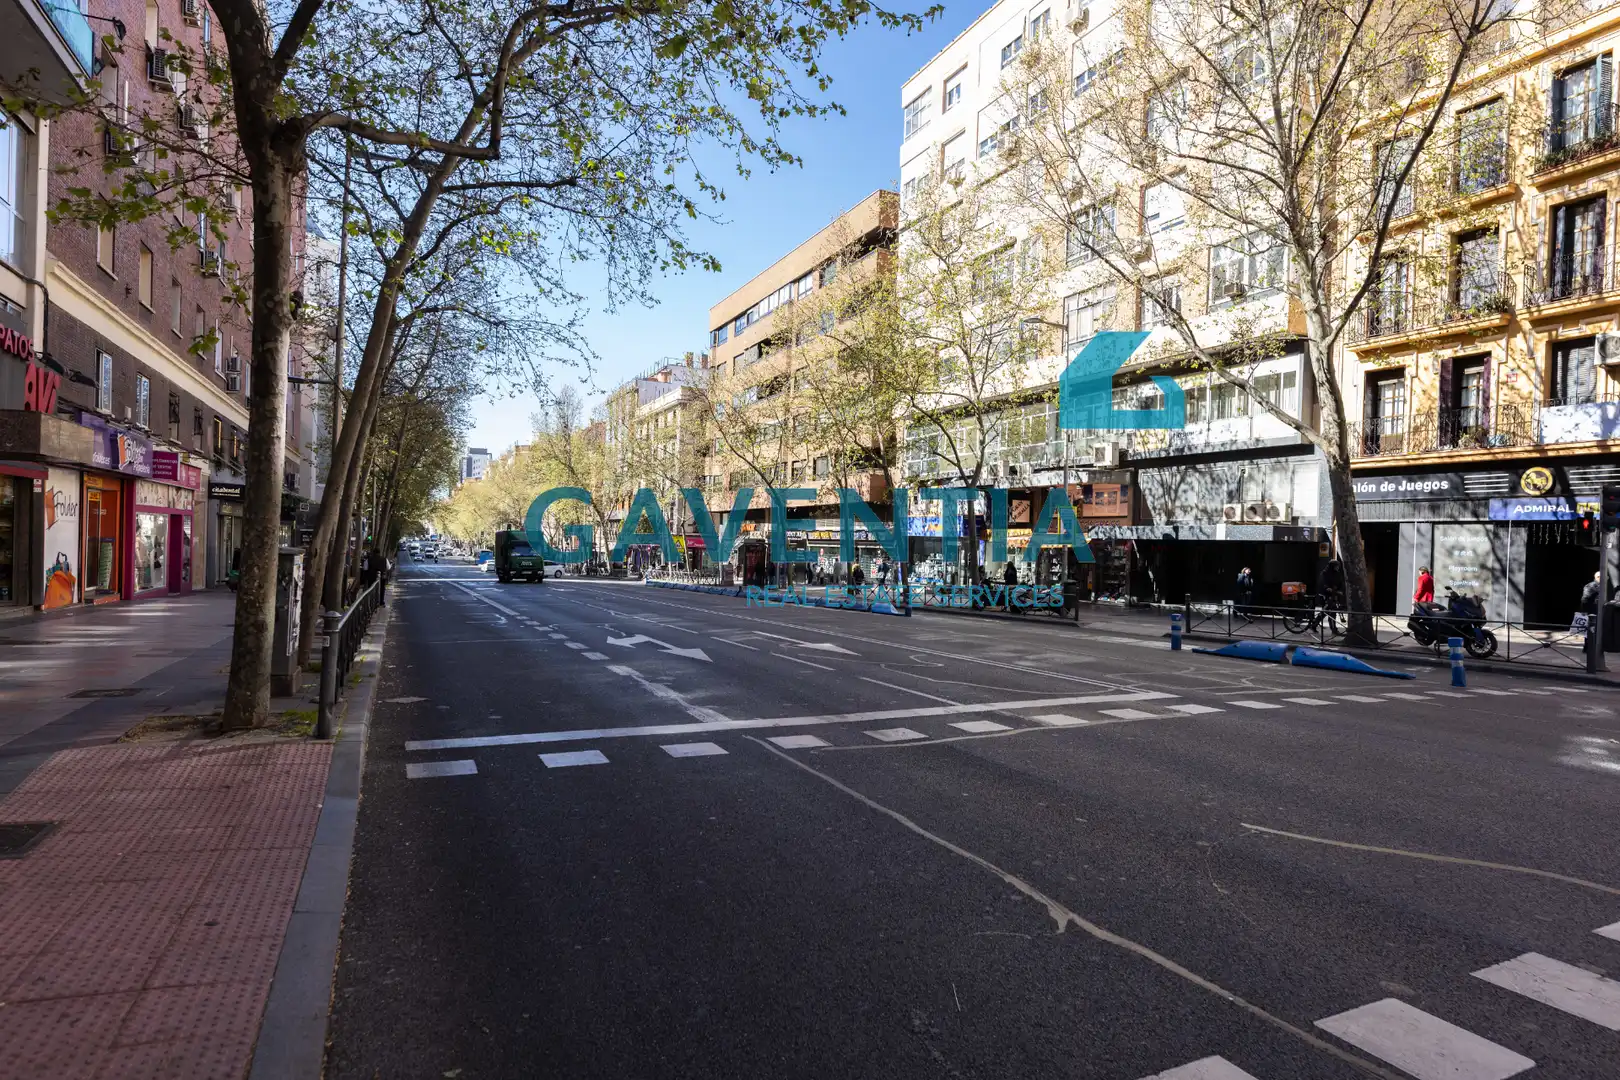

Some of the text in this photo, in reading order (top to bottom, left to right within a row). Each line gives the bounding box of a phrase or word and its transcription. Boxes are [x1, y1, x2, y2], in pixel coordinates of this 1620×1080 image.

[1352, 480, 1449, 493] alón de Juegos
[1513, 503, 1574, 514] ADMIRAL
